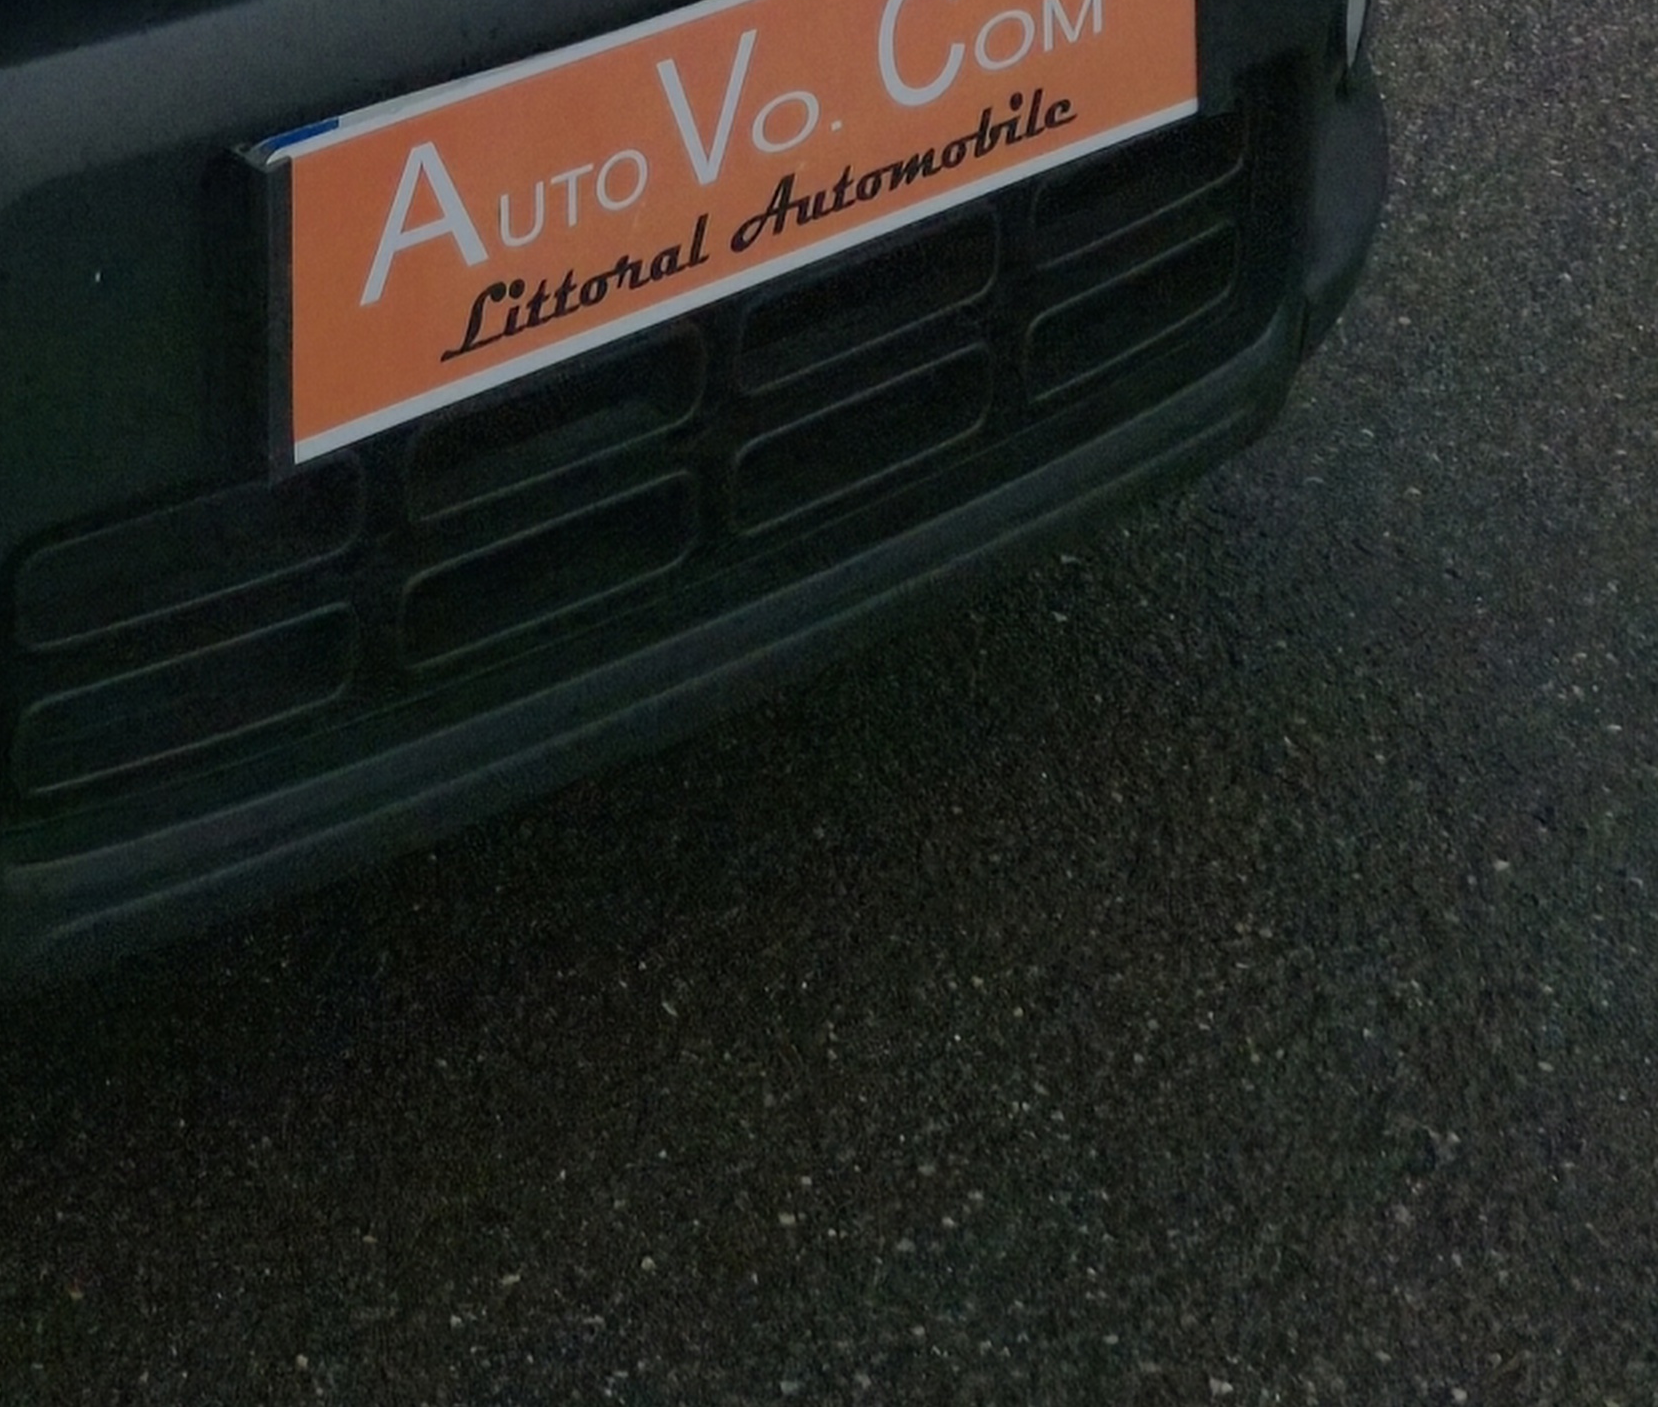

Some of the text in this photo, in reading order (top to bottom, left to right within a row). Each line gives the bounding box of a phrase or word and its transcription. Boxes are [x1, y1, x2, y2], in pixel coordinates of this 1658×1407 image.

[359, 140, 650, 308] AUTO
[655, 28, 843, 187] VO.
[440, 88, 1078, 363] Littoral Automobile
